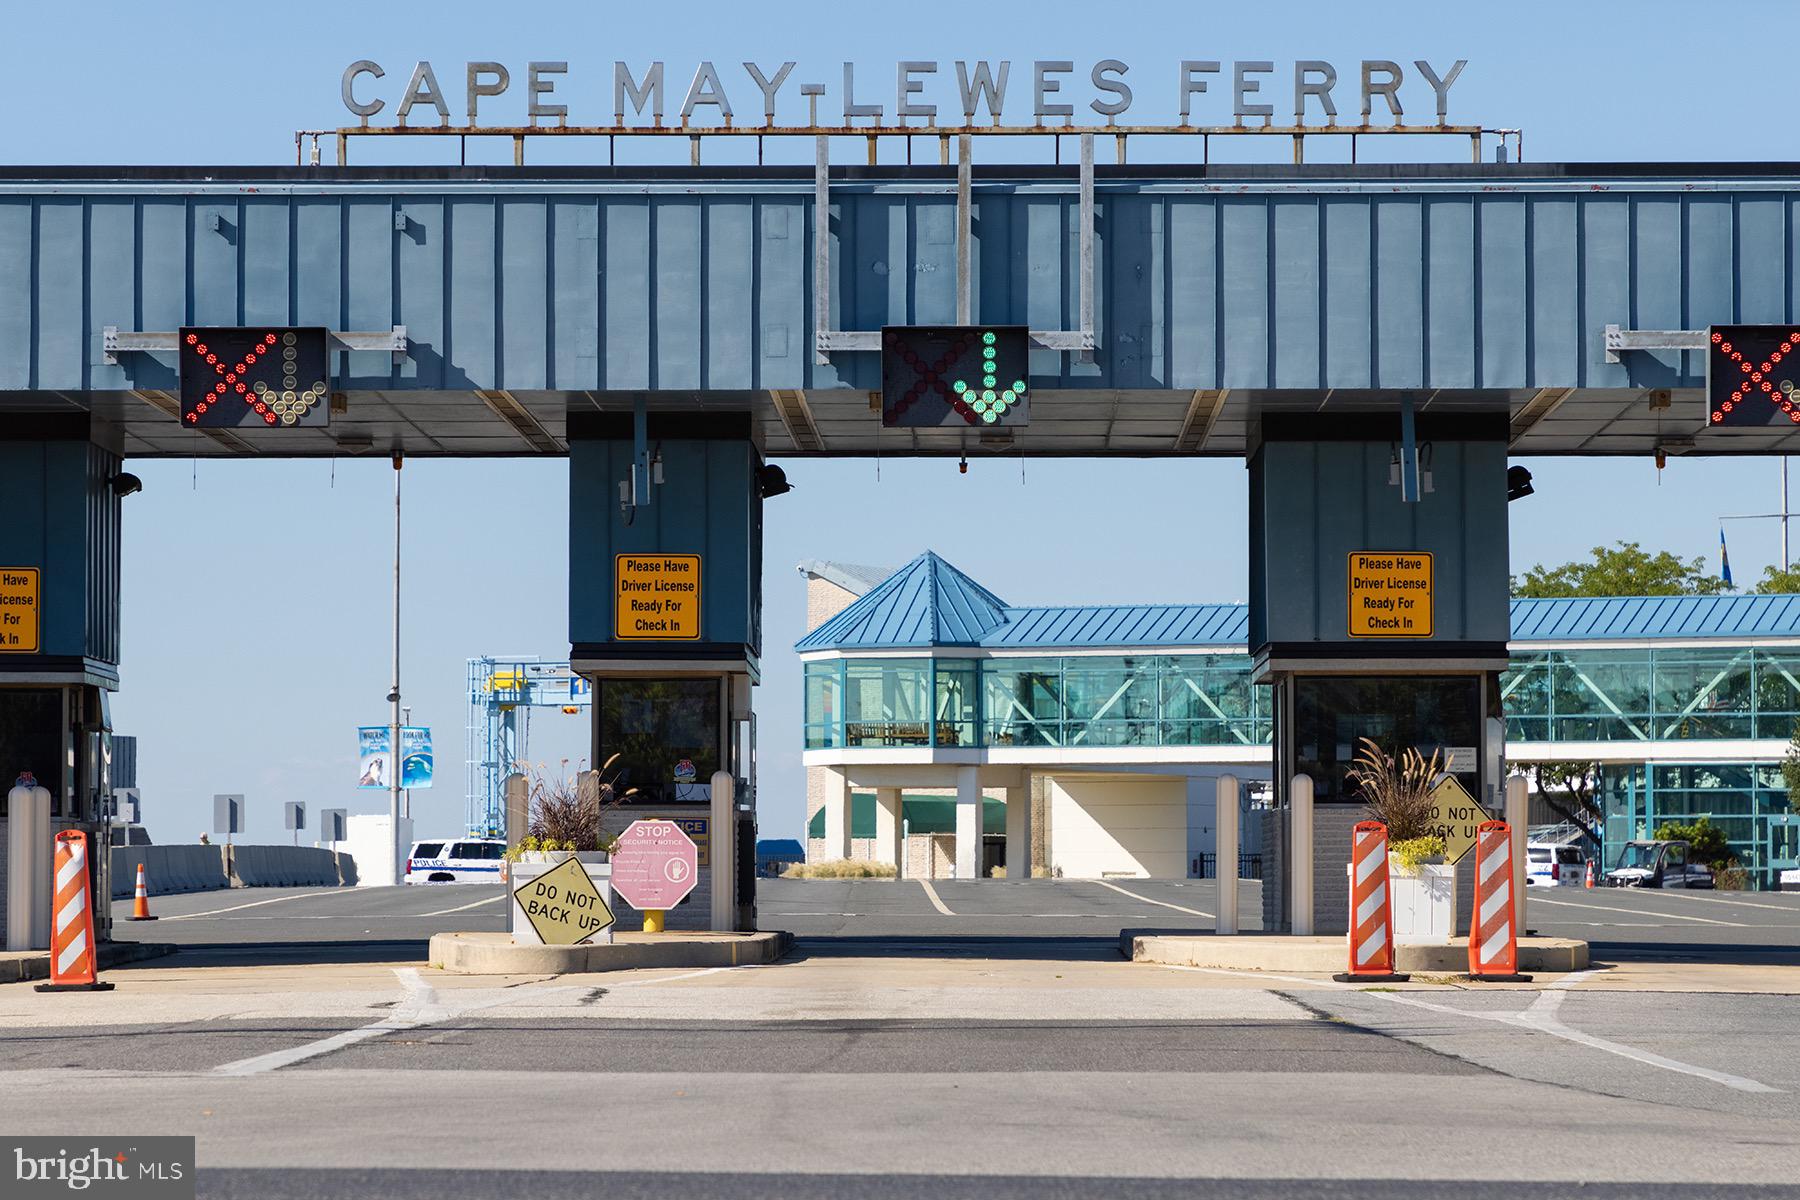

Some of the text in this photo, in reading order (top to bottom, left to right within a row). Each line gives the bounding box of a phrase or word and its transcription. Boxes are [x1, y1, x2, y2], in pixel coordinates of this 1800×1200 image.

[341, 59, 568, 116] CAPE
[1180, 60, 1468, 116] FERRY
[627, 560, 689, 572] Please Have
[1359, 557, 1421, 569] Please Have
[3, 574, 28, 585] Have
[622, 580, 694, 591] Driver License
[1354, 577, 1426, 589] Driver License
[0, 593, 33, 605] icense
[1363, 597, 1414, 611] Ready For
[631, 599, 681, 614] Ready For
[4, 613, 21, 624] For
[1368, 616, 1413, 628] Check In
[635, 619, 680, 631] Check In
[9, 633, 19, 644] In
[1448, 807, 1476, 820] NOT
[635, 826, 671, 837] STOP
[1421, 824, 1455, 838] ACK
[413, 859, 447, 867] POLICE
[535, 882, 597, 910] DO NOT
[528, 900, 600, 931] BACK UP
